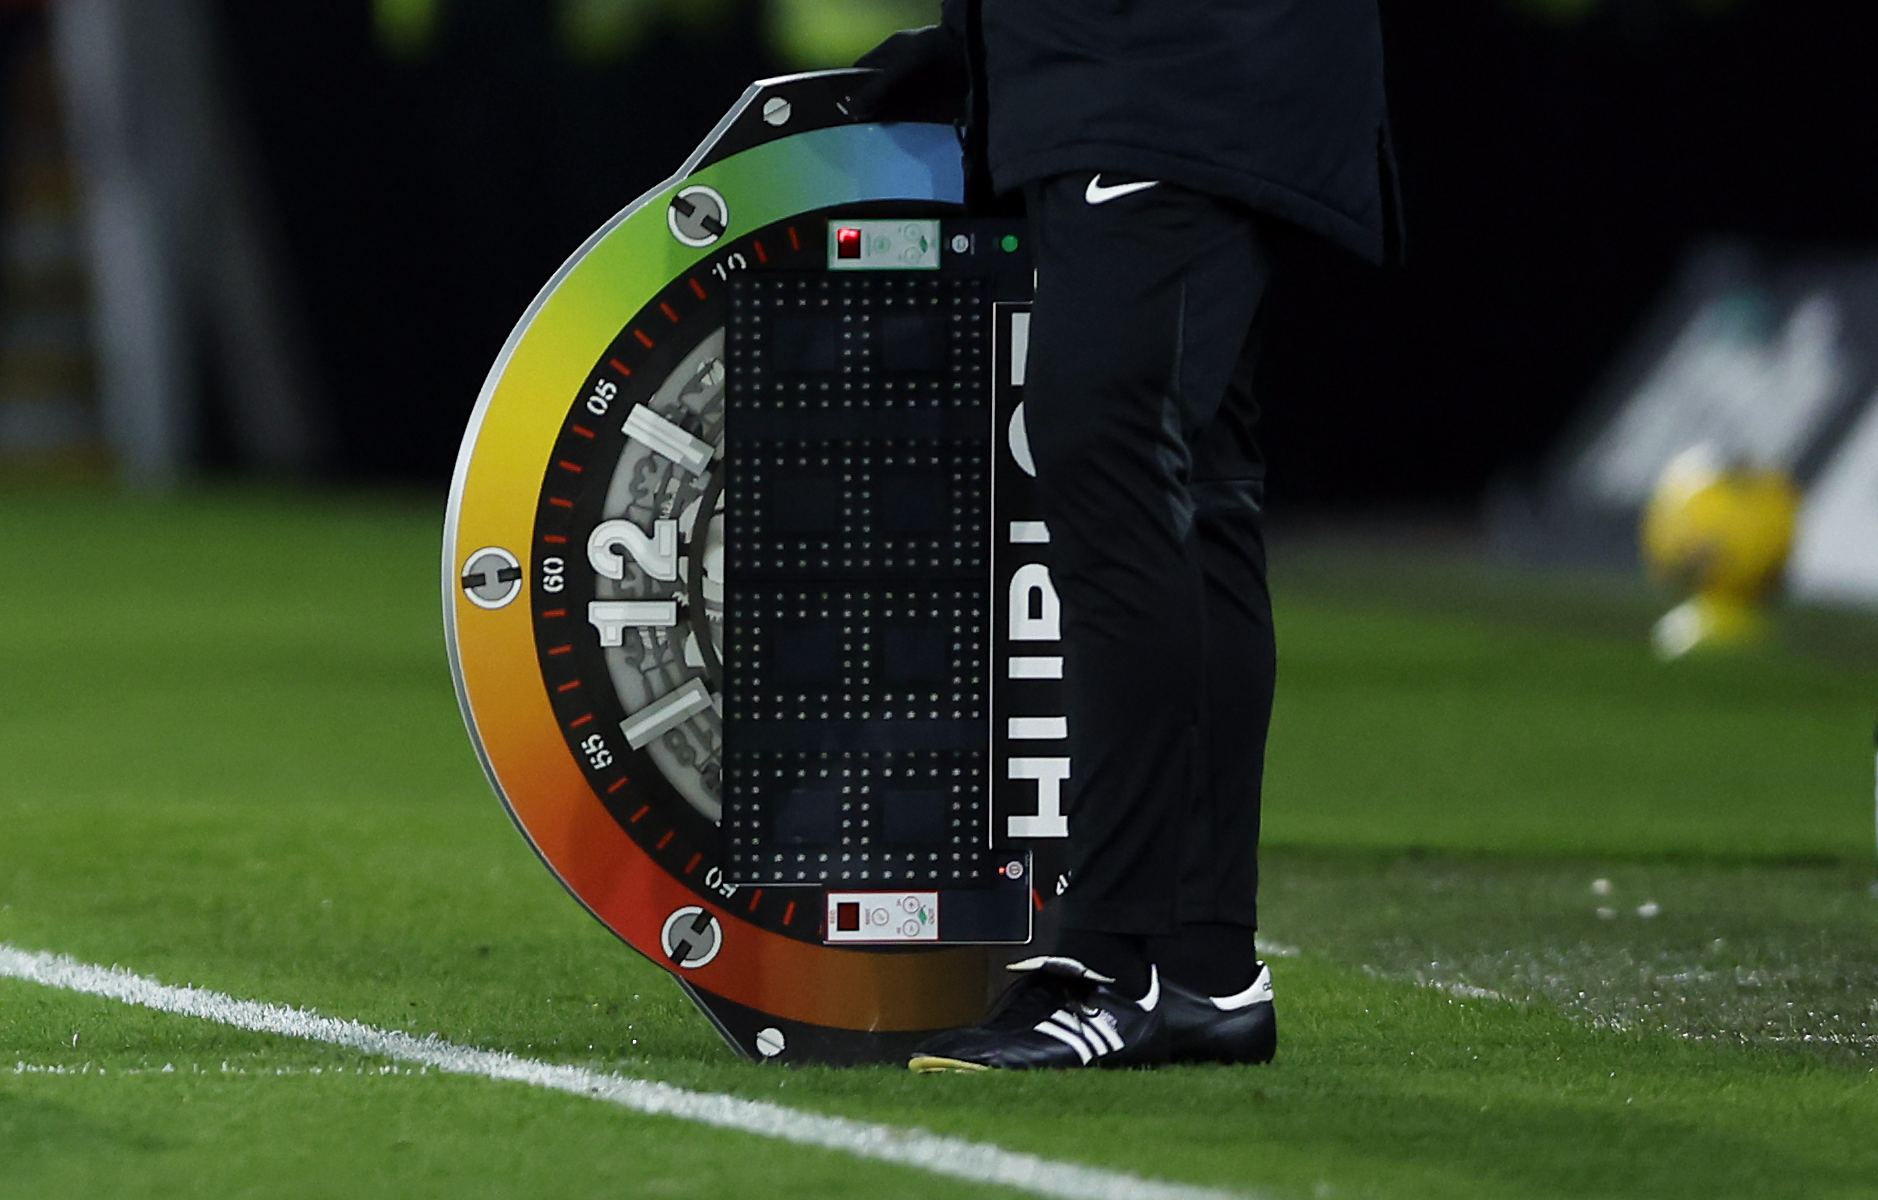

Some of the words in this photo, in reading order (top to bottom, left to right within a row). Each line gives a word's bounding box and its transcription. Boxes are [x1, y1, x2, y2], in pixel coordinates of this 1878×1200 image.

[586, 378, 618, 416] 05
[542, 556, 565, 593] 60
[587, 518, 678, 648] 12
[580, 733, 613, 771] 55
